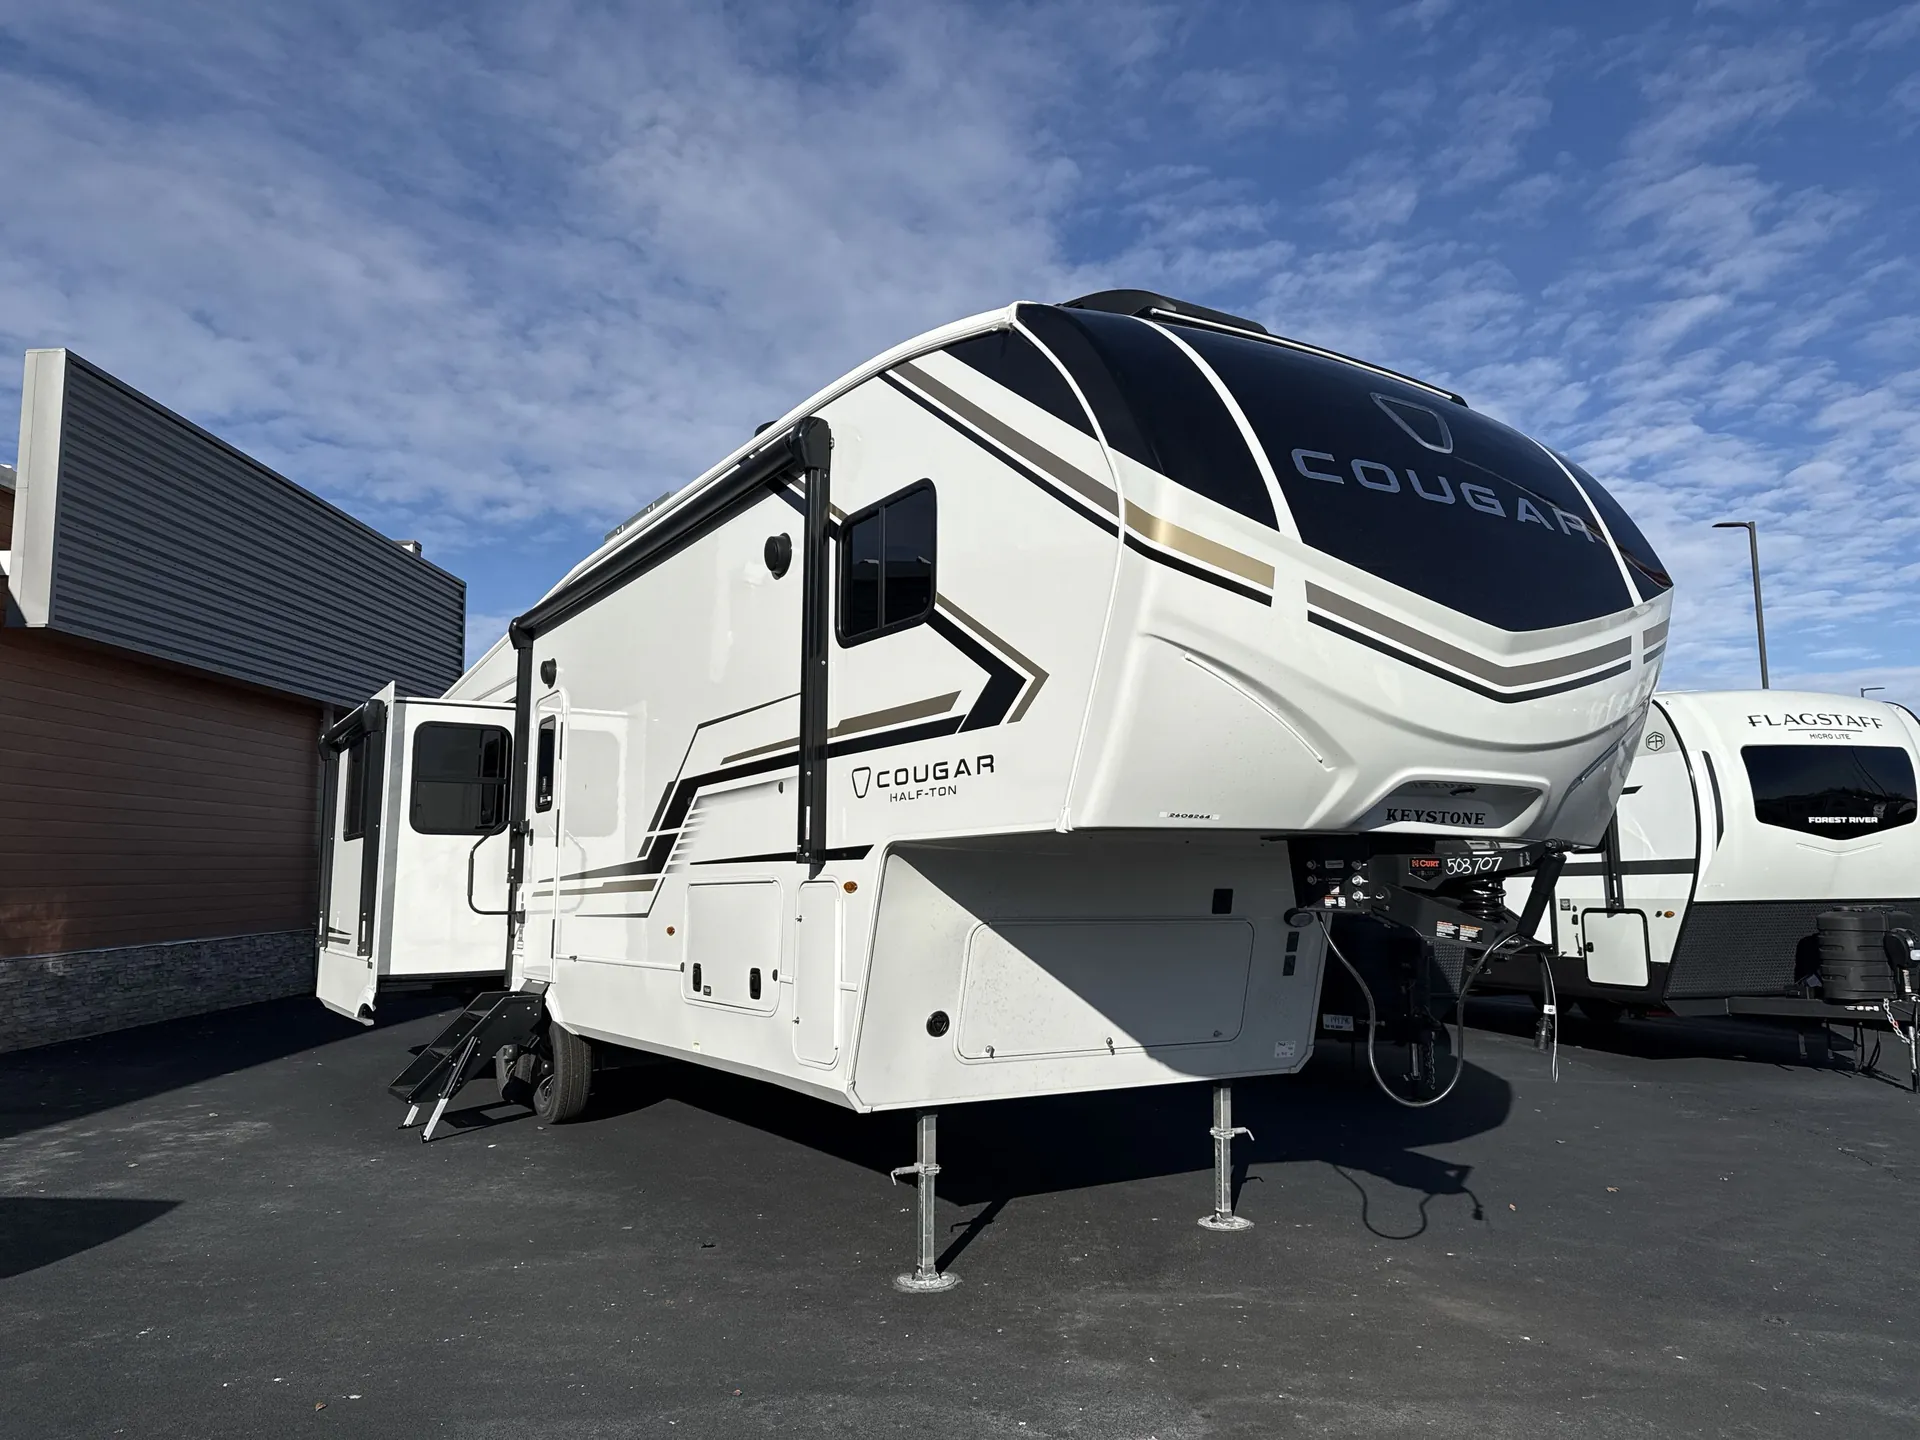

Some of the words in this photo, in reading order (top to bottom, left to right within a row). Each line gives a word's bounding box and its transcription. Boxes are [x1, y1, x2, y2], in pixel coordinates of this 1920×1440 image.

[1291, 448, 1596, 543] COUGAR
[1747, 713, 1883, 729] FLAGSTAFF
[876, 754, 995, 789] COUGAR
[889, 785, 957, 803] HALF-TON
[1385, 808, 1486, 825] KEYSTONE
[1808, 816, 1847, 824] FOREST
[1849, 816, 1878, 824] RIVER
[1419, 859, 1440, 868] CURT
[1445, 856, 1503, 875] 503707
